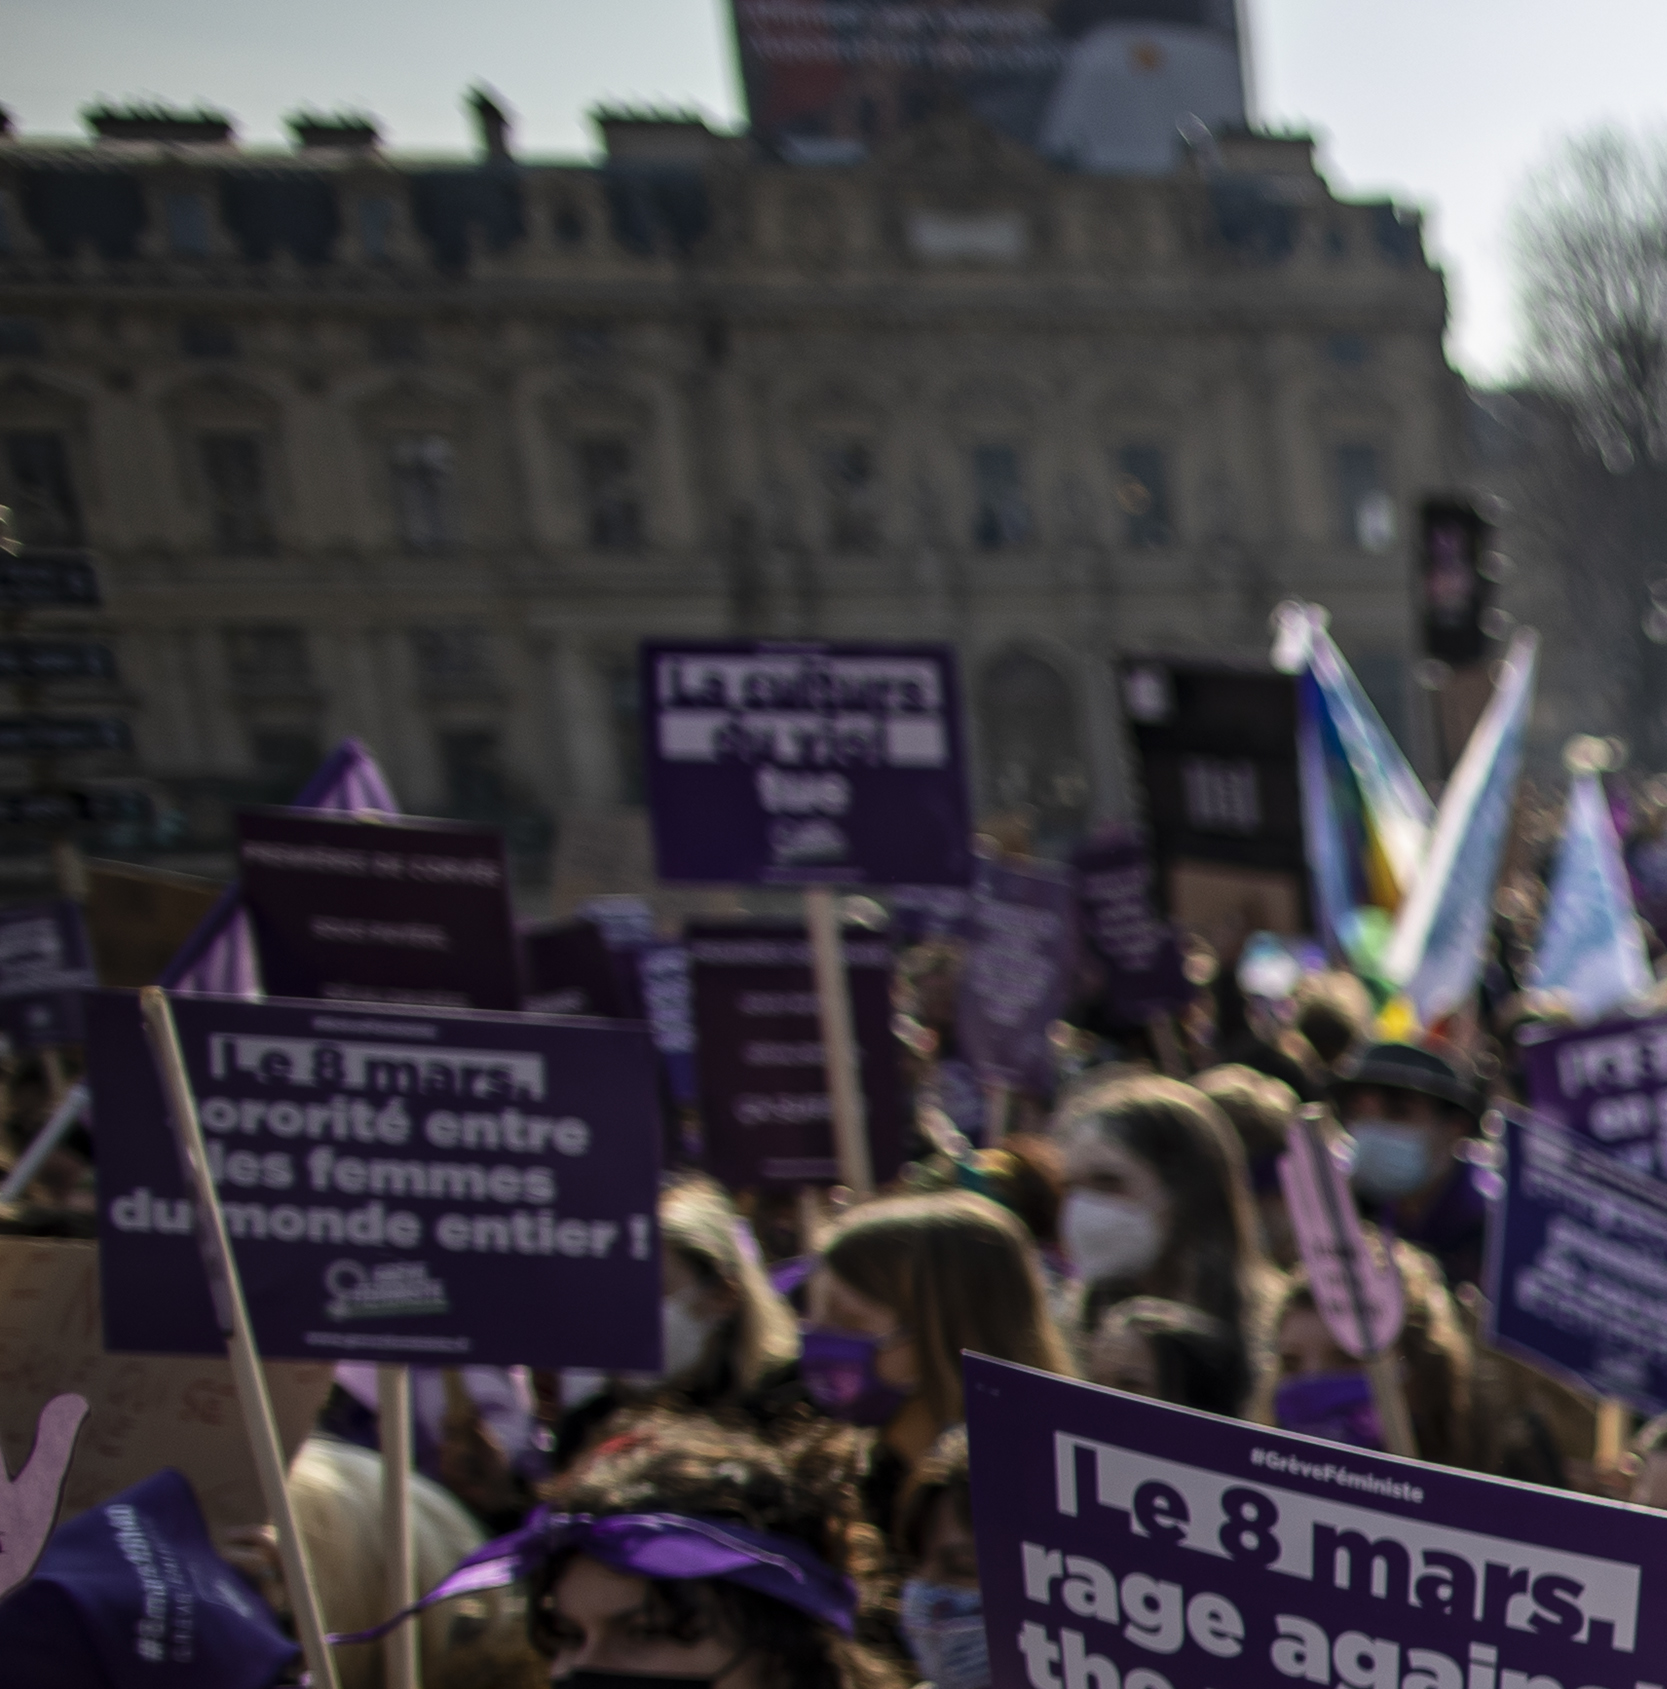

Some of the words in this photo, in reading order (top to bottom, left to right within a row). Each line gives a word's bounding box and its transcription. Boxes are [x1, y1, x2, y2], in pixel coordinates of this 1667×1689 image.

[224, 1037, 292, 1086] Le
[313, 1044, 346, 1086] 8
[203, 1096, 411, 1146] ororité
[425, 1104, 591, 1157] entre
[307, 1145, 558, 1205] femmes
[109, 1186, 193, 1234] du
[222, 1199, 424, 1249] monde
[435, 1210, 619, 1258] entier
[1250, 1446, 1425, 1504] #GrèveFéministe
[1074, 1442, 1191, 1543] Le
[1218, 1486, 1280, 1570] 8
[1311, 1520, 1614, 1650] mars,
[1020, 1540, 1247, 1655] rage
